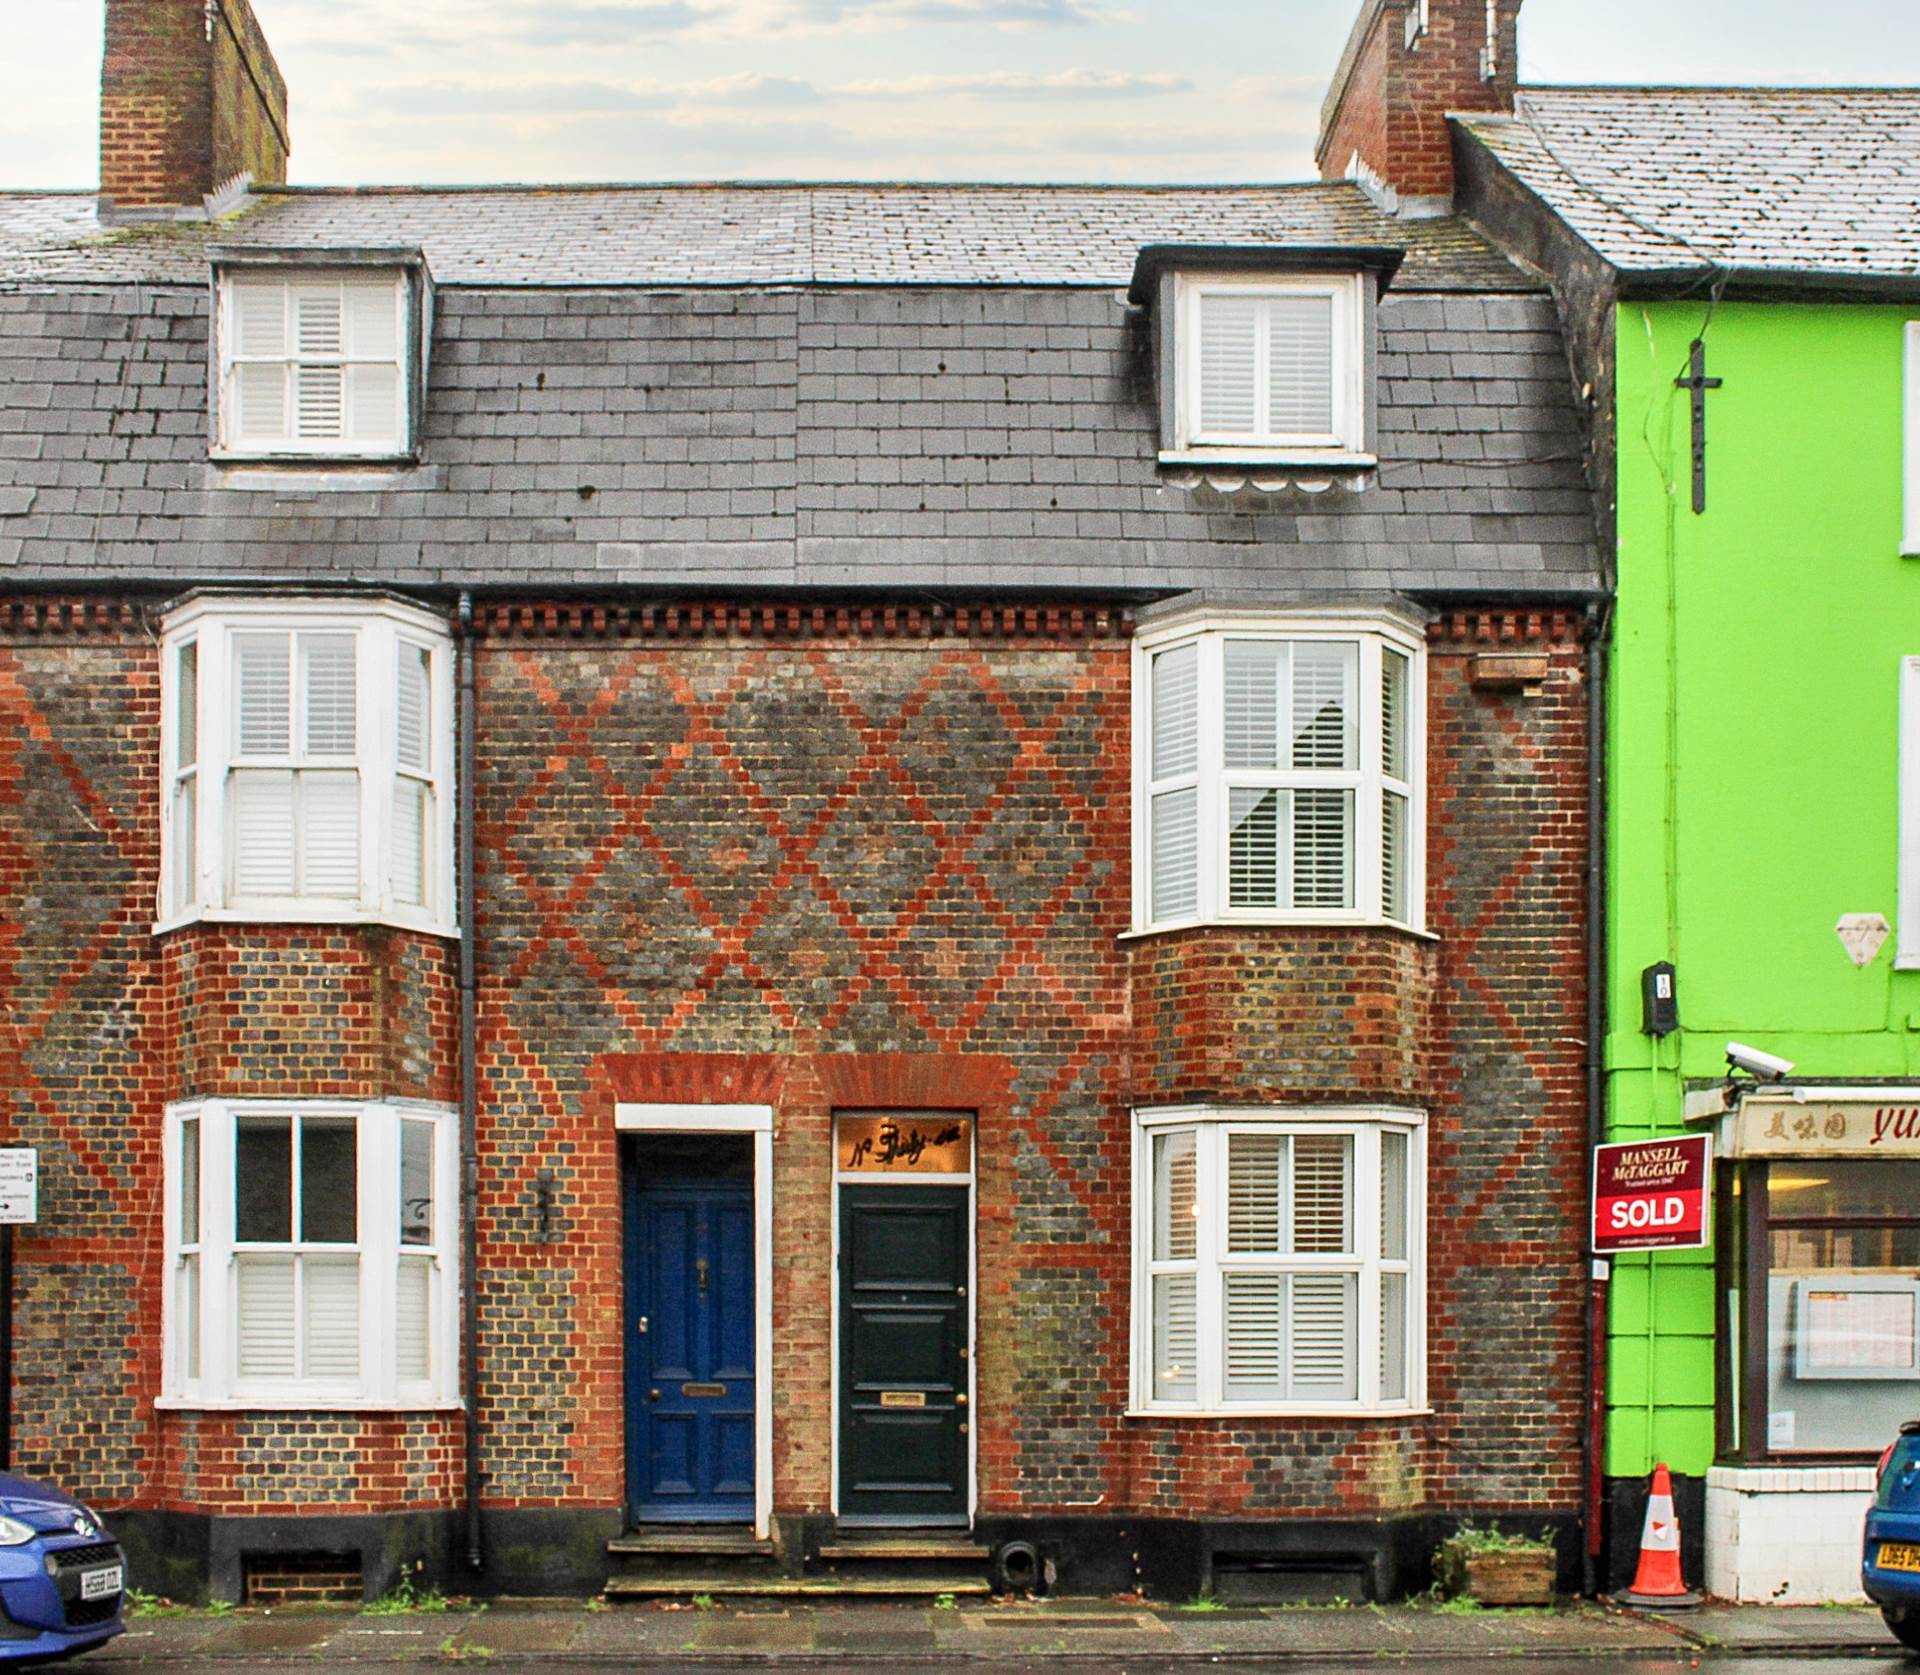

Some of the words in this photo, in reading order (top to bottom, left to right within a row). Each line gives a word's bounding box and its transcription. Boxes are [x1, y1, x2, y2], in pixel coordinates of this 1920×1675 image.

[1620, 1147, 1682, 1166] MANSELL
[1612, 1160, 1690, 1181] McTAGGART
[1611, 1197, 1685, 1229] SOLD
